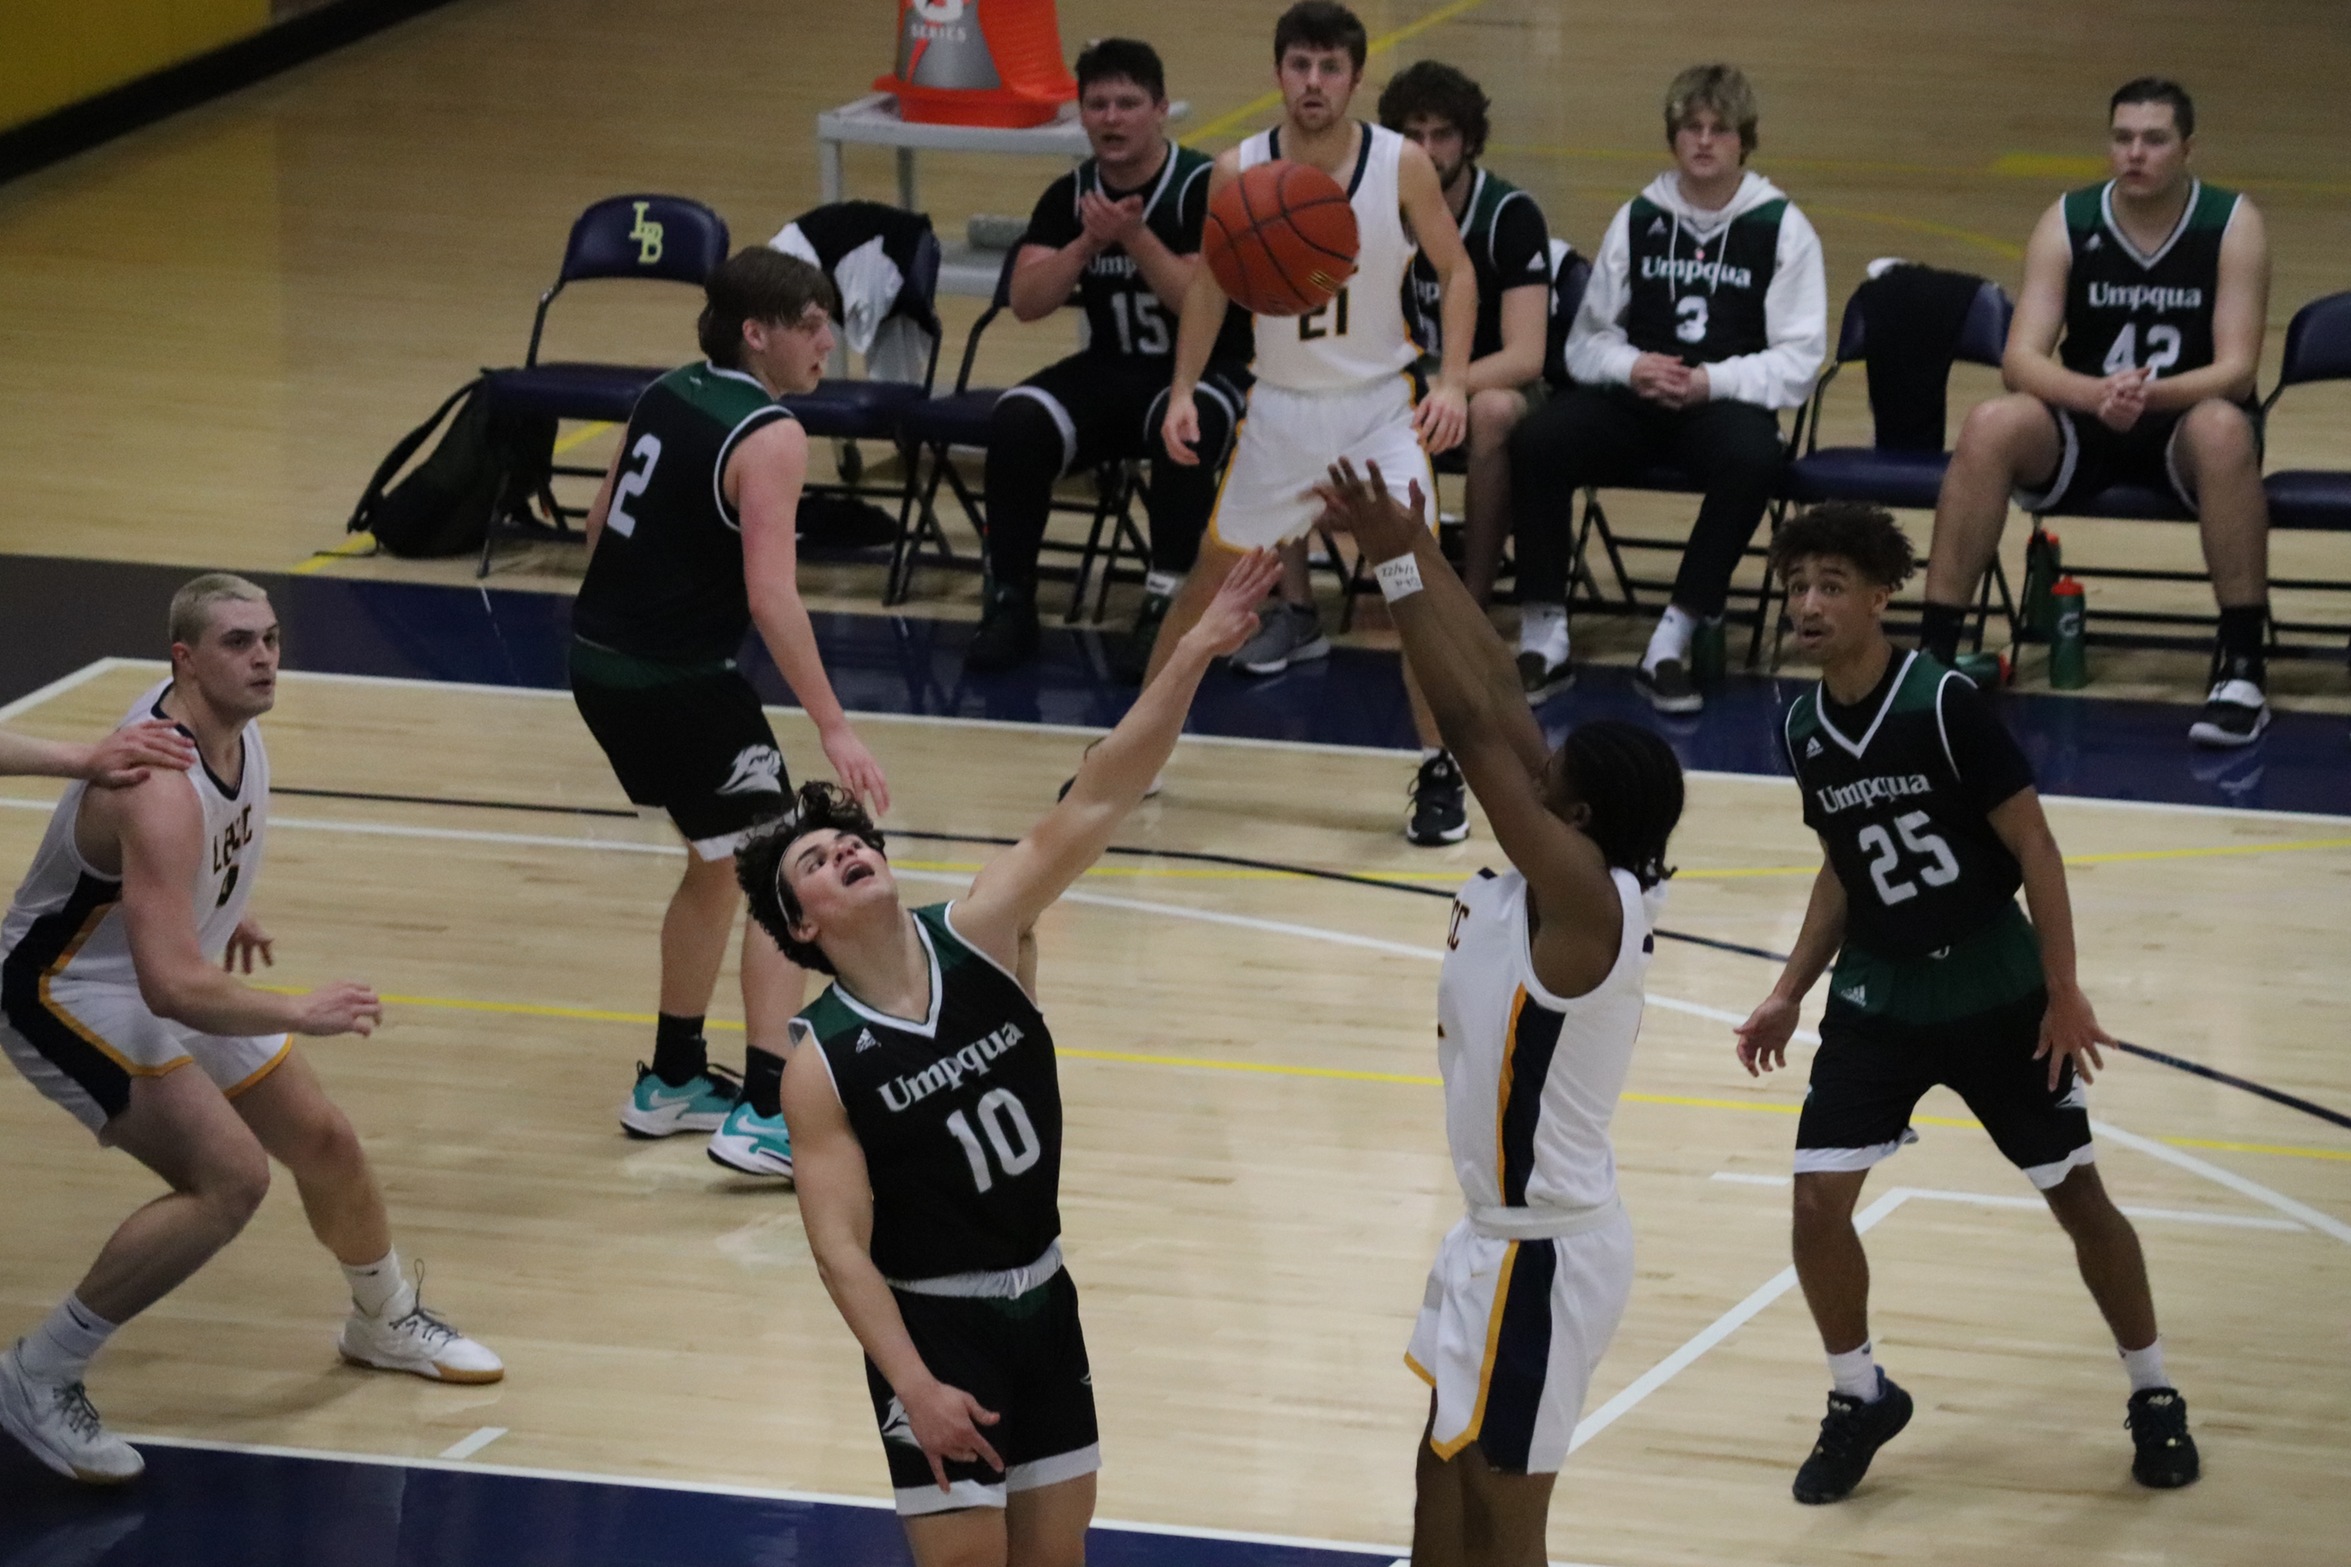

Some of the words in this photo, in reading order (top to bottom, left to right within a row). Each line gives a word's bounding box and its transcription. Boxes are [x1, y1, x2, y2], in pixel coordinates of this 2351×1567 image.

[1641, 255, 1752, 288] Umpqua
[2088, 281, 2202, 312] Umpqua
[1112, 292, 1170, 354] 15
[1299, 286, 1348, 340] 21
[1676, 295, 1708, 342] 3
[2102, 322, 2181, 381] 42
[607, 432, 661, 538] 2
[1816, 773, 1933, 815] Umpqua
[1858, 810, 1960, 906] 25
[877, 1021, 1025, 1112] Umpqua
[946, 1087, 1041, 1194] 10
